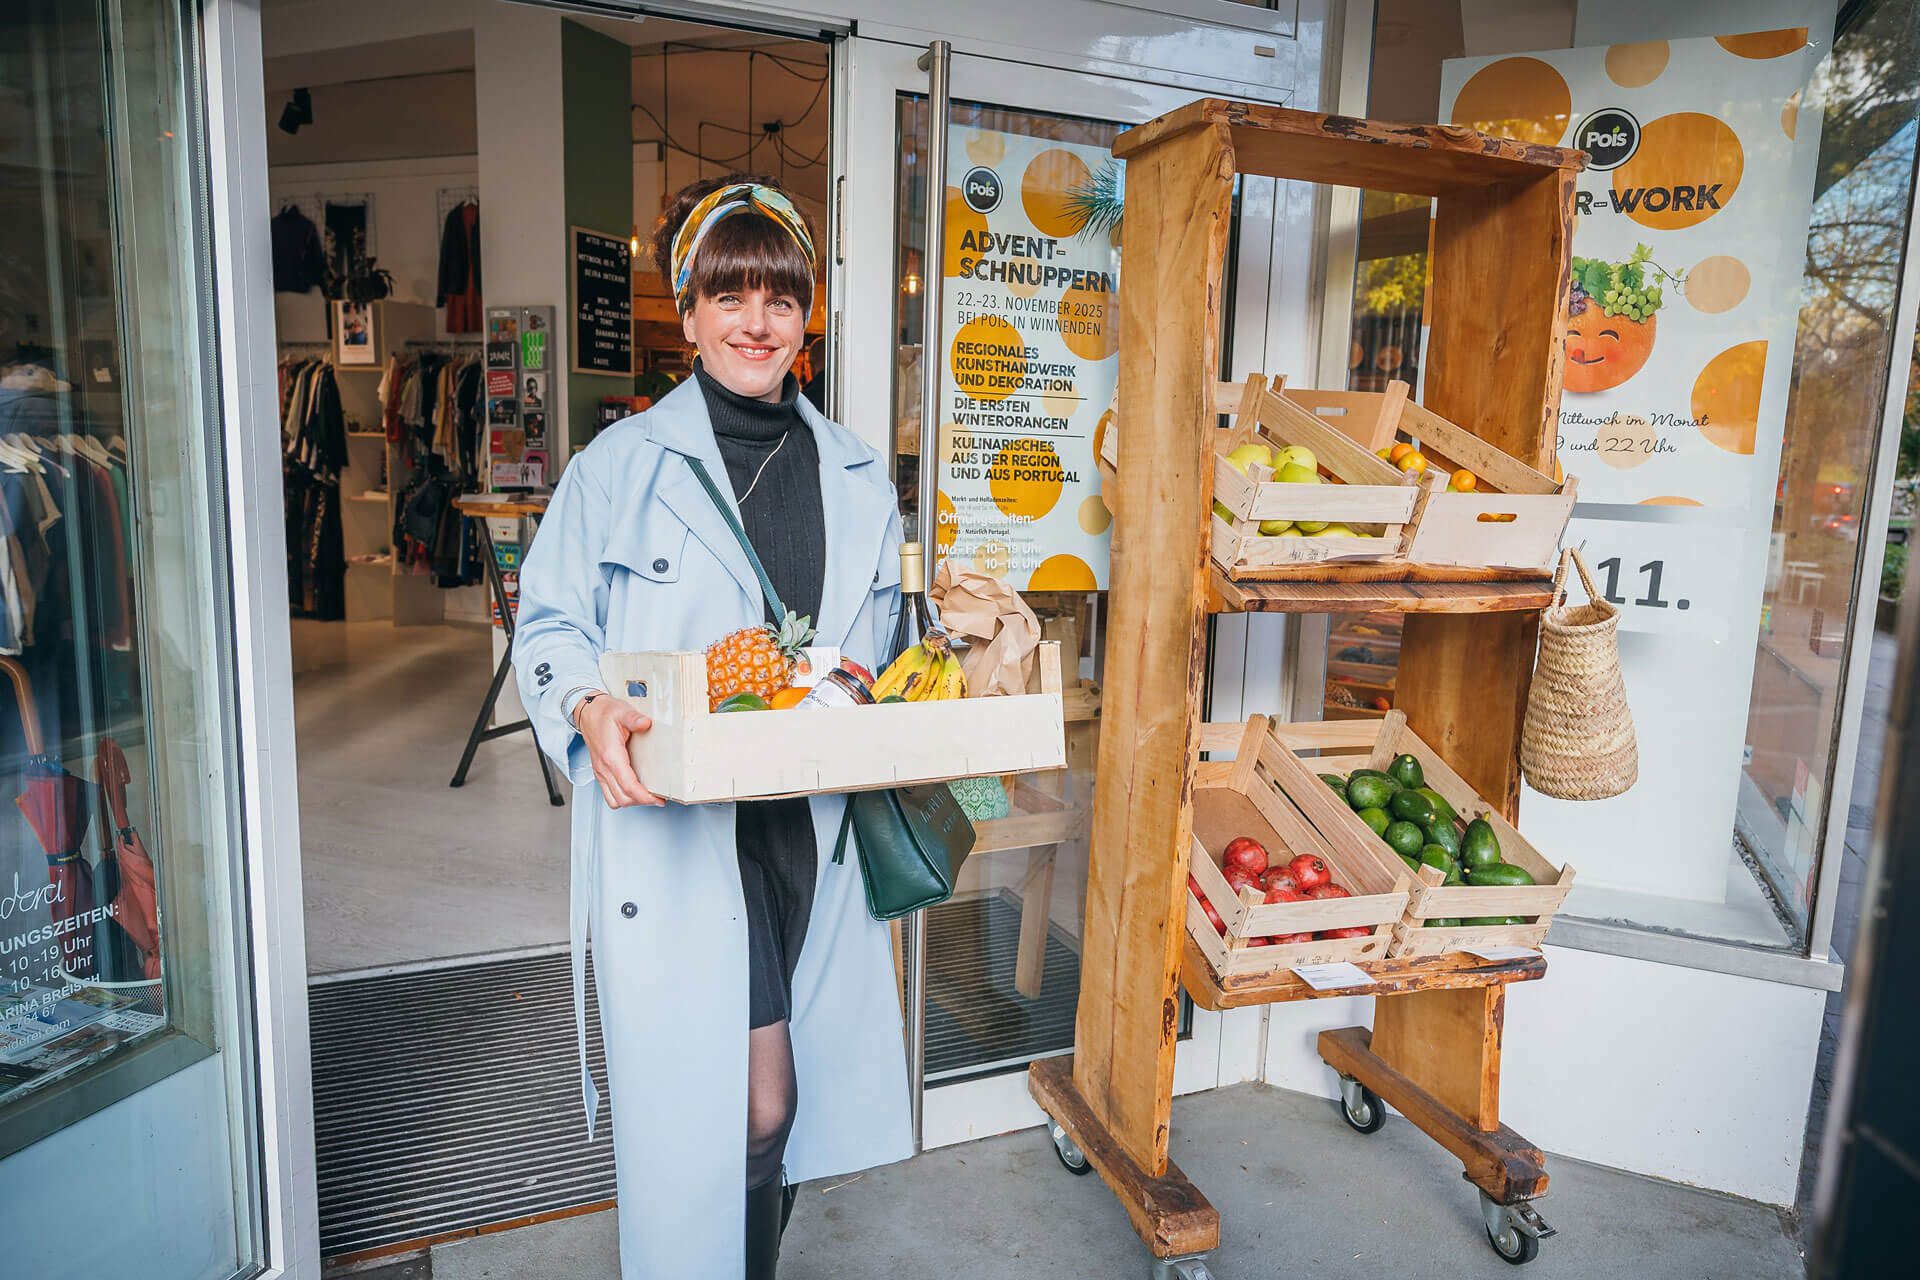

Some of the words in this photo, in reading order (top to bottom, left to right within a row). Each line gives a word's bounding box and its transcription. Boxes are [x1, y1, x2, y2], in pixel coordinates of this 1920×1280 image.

[1575, 183, 1723, 216] R-WORK
[959, 229, 1066, 260] ADVENT-
[959, 257, 1117, 293] SCHNUPPERN
[1005, 297, 1070, 315] NOVEMBER
[1074, 303, 1103, 318] 2025
[958, 311, 976, 325] BEI
[981, 313, 1008, 328] POIS
[1013, 316, 1025, 330] IN
[1031, 319, 1101, 336] WINNENDEN
[956, 341, 1040, 360] REGIONALES
[956, 358, 1077, 378] KUNSTHANDWERK
[955, 373, 985, 387] UND
[988, 375, 1073, 393] DEKORATION
[954, 397, 976, 410] DIE
[980, 400, 1030, 413] ERSTEN
[952, 412, 1069, 430] WINTERORANGEN
[1626, 415, 1645, 426] im
[1651, 412, 1709, 427] Monat
[952, 436, 1055, 453] KULINARISCHES
[1570, 438, 1599, 450] und
[1604, 437, 1634, 452] 22
[1640, 437, 1677, 454] Uhr
[951, 452, 978, 465] AUS
[982, 453, 1009, 466] DER
[1011, 455, 1060, 468] REGION
[951, 467, 981, 480] UND
[984, 468, 1011, 481] AUS
[1013, 470, 1080, 483] PORTUGAL
[0, 869, 66, 920] derei
[0, 903, 119, 955] UNGSZEITEN:
[9, 956, 29, 974] 10
[64, 935, 92, 954] Uhr
[11, 976, 30, 993] 10
[65, 954, 93, 973] Uhr
